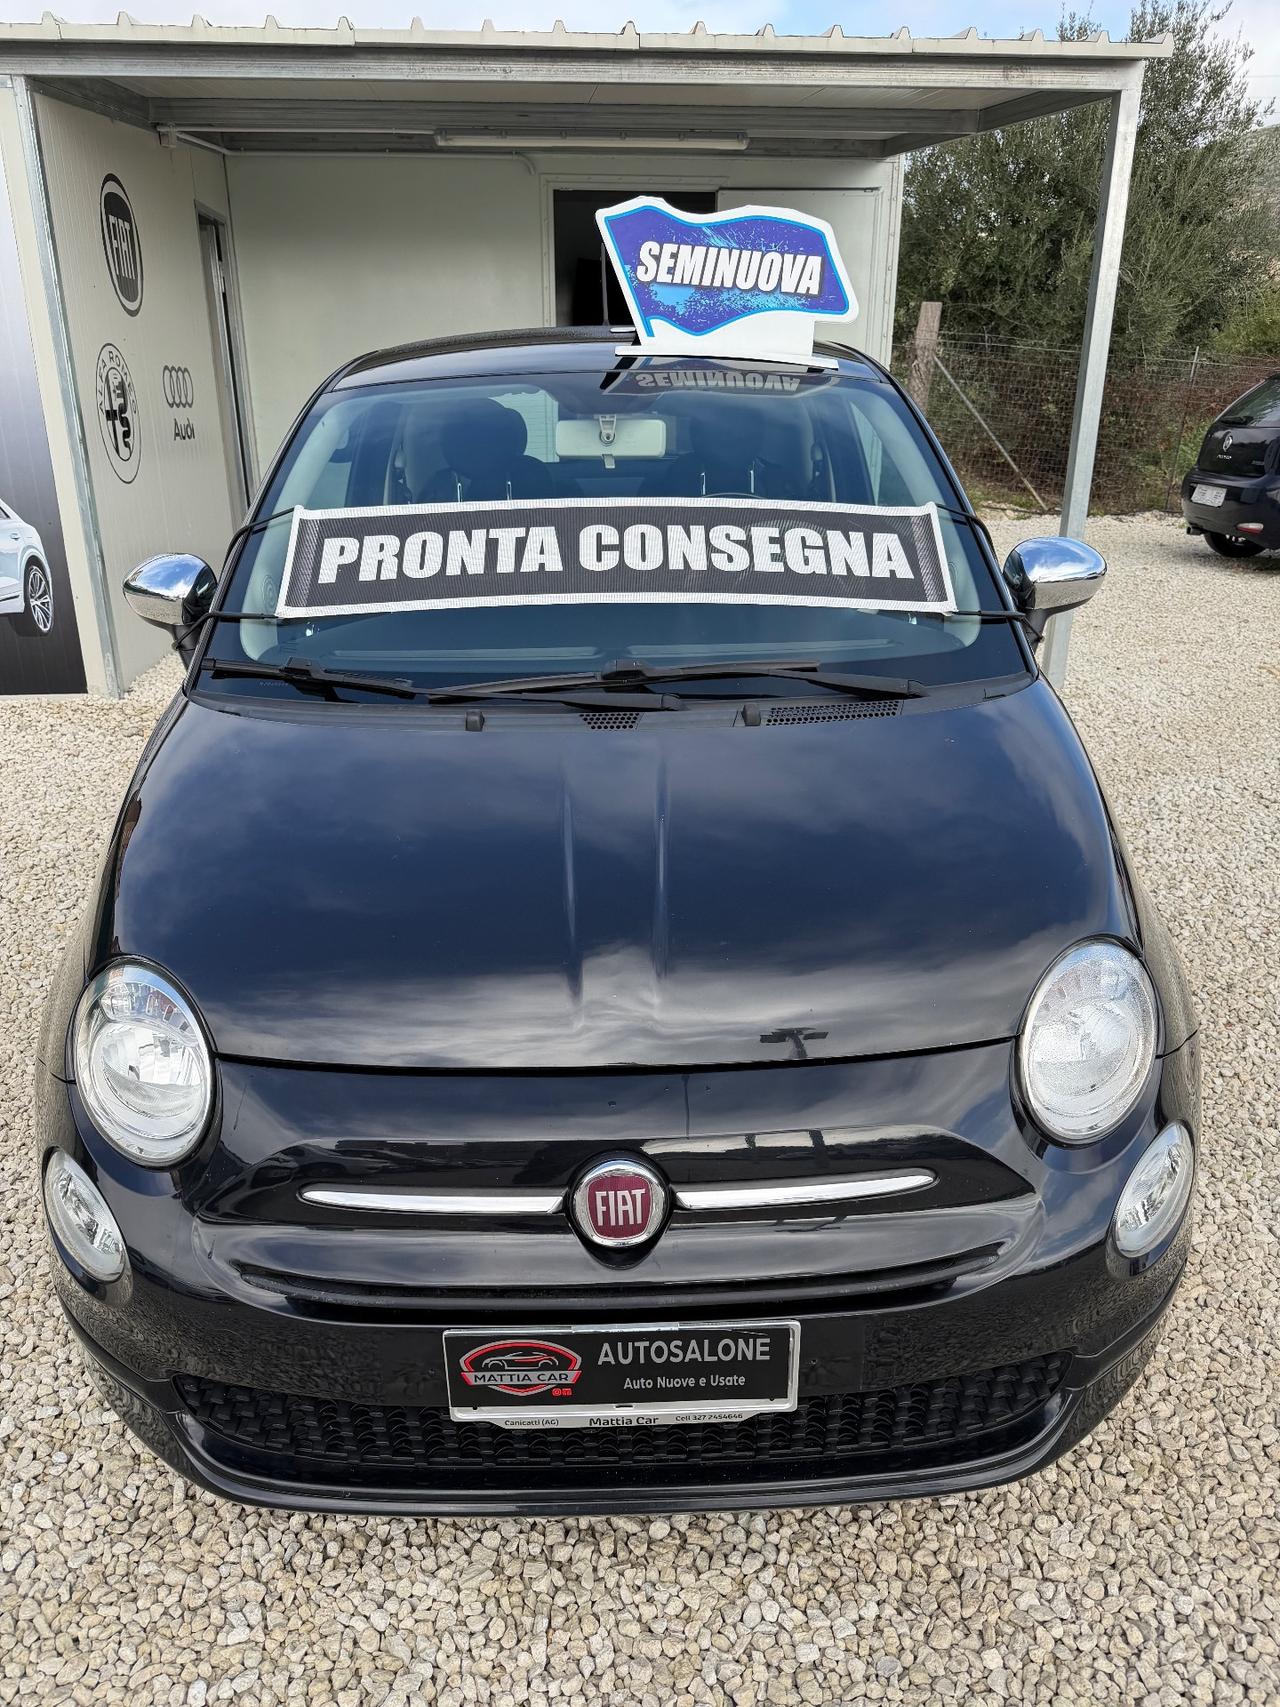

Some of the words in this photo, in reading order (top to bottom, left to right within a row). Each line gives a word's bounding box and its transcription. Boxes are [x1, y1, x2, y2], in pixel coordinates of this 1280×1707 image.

[108, 214, 136, 280] FIAT
[636, 241, 823, 295] SEMINUOVA
[173, 417, 196, 441] Audi
[317, 526, 564, 584] PRONTA
[578, 523, 916, 580] CONSEGNA
[595, 1188, 646, 1227] FIAT
[597, 1337, 771, 1366] AUTOSALONE
[474, 1373, 533, 1383] MATTIA
[537, 1373, 570, 1382] CAR
[623, 1376, 653, 1390] Auto
[657, 1375, 696, 1389] Nuove
[699, 1377, 707, 1387] e
[710, 1373, 746, 1387] Usate
[541, 1418, 559, 1427] (AG)
[588, 1416, 633, 1427] Mattia
[636, 1415, 660, 1425] Car
